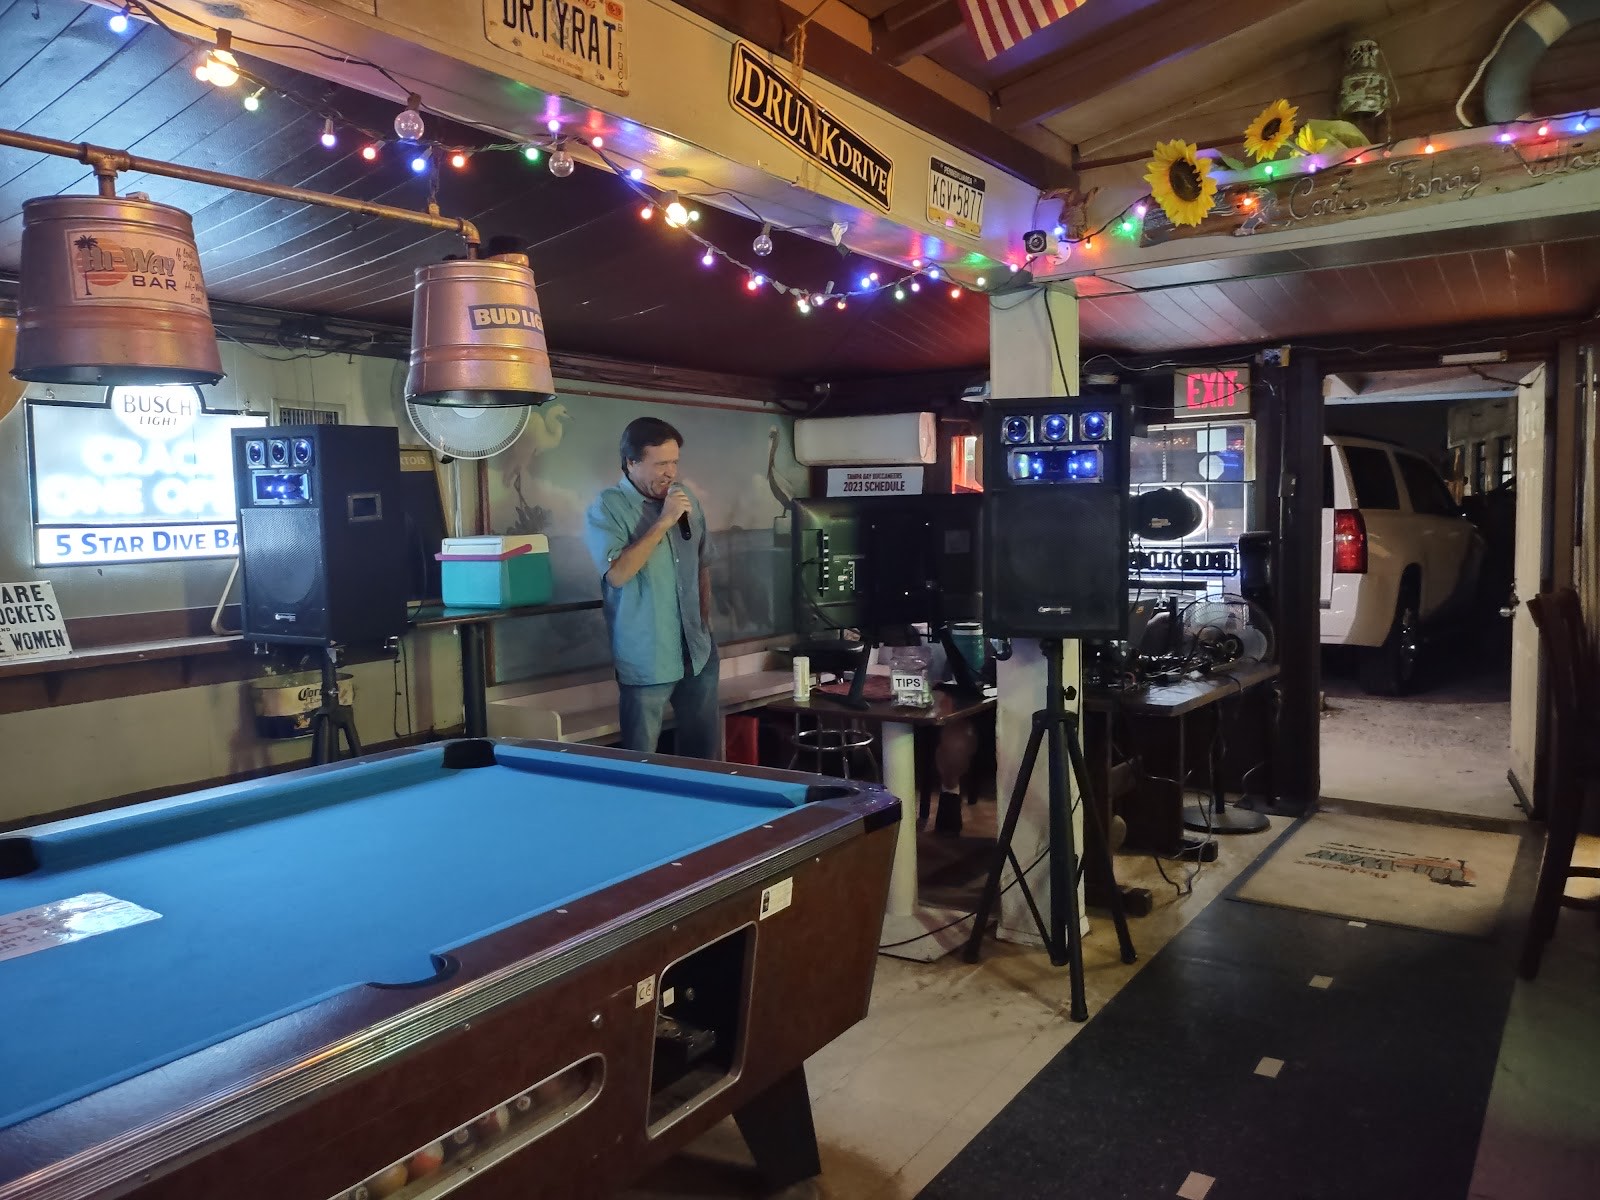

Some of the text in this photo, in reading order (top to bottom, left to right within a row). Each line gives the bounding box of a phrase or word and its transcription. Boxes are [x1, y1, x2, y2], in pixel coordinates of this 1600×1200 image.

[741, 58, 888, 196] DRUNK DRIVE
[132, 275, 178, 292] BAR
[473, 308, 520, 326] BUD
[1186, 370, 1239, 409] EXIT
[124, 394, 192, 416] BUSCH
[140, 416, 177, 426] LIGHT
[843, 480, 906, 492] 2023 SCHEDULE
[56, 534, 72, 556] 5
[81, 532, 144, 555] STAR
[152, 530, 207, 552] DIVE
[2, 584, 45, 605] ARE
[9, 629, 66, 652] WOMEN
[895, 678, 921, 688] TIPS
